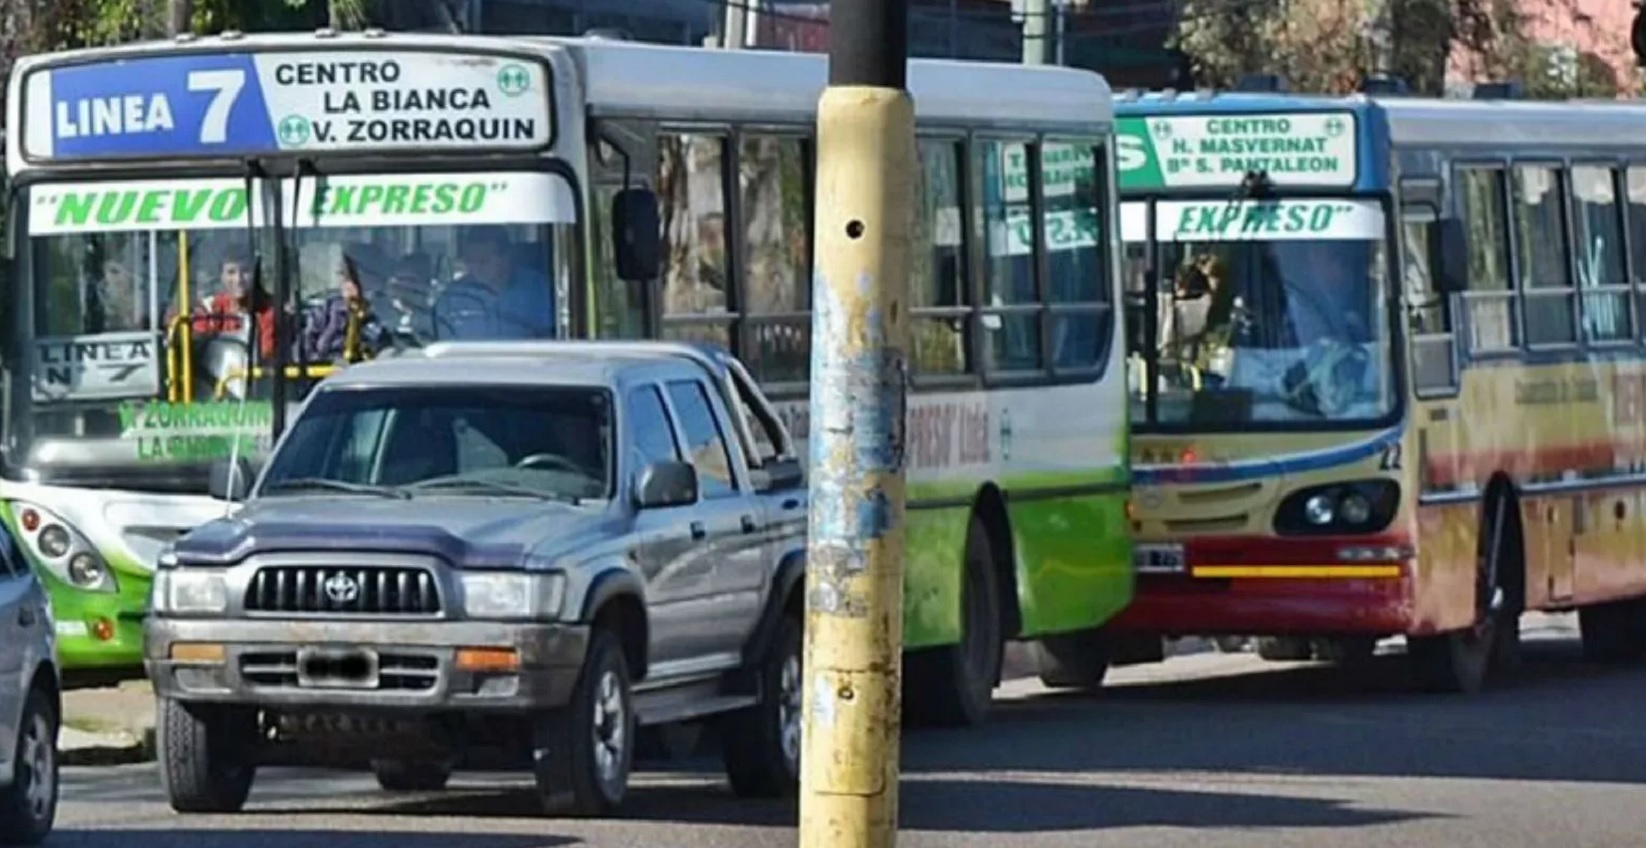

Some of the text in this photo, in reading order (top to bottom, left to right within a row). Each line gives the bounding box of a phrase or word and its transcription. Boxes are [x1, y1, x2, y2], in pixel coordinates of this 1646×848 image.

[274, 60, 401, 86] CENTRO
[56, 69, 246, 144] LINEA 7
[324, 88, 490, 114] LA BIANCA
[312, 118, 535, 143] V. ZORRAQUIN
[1206, 118, 1291, 134] CENTRO
[1172, 138, 1327, 154] H. MASVERNAT
[1220, 156, 1338, 173] PANTALEON
[40, 341, 151, 363] LINEA
[97, 363, 148, 382] 7
